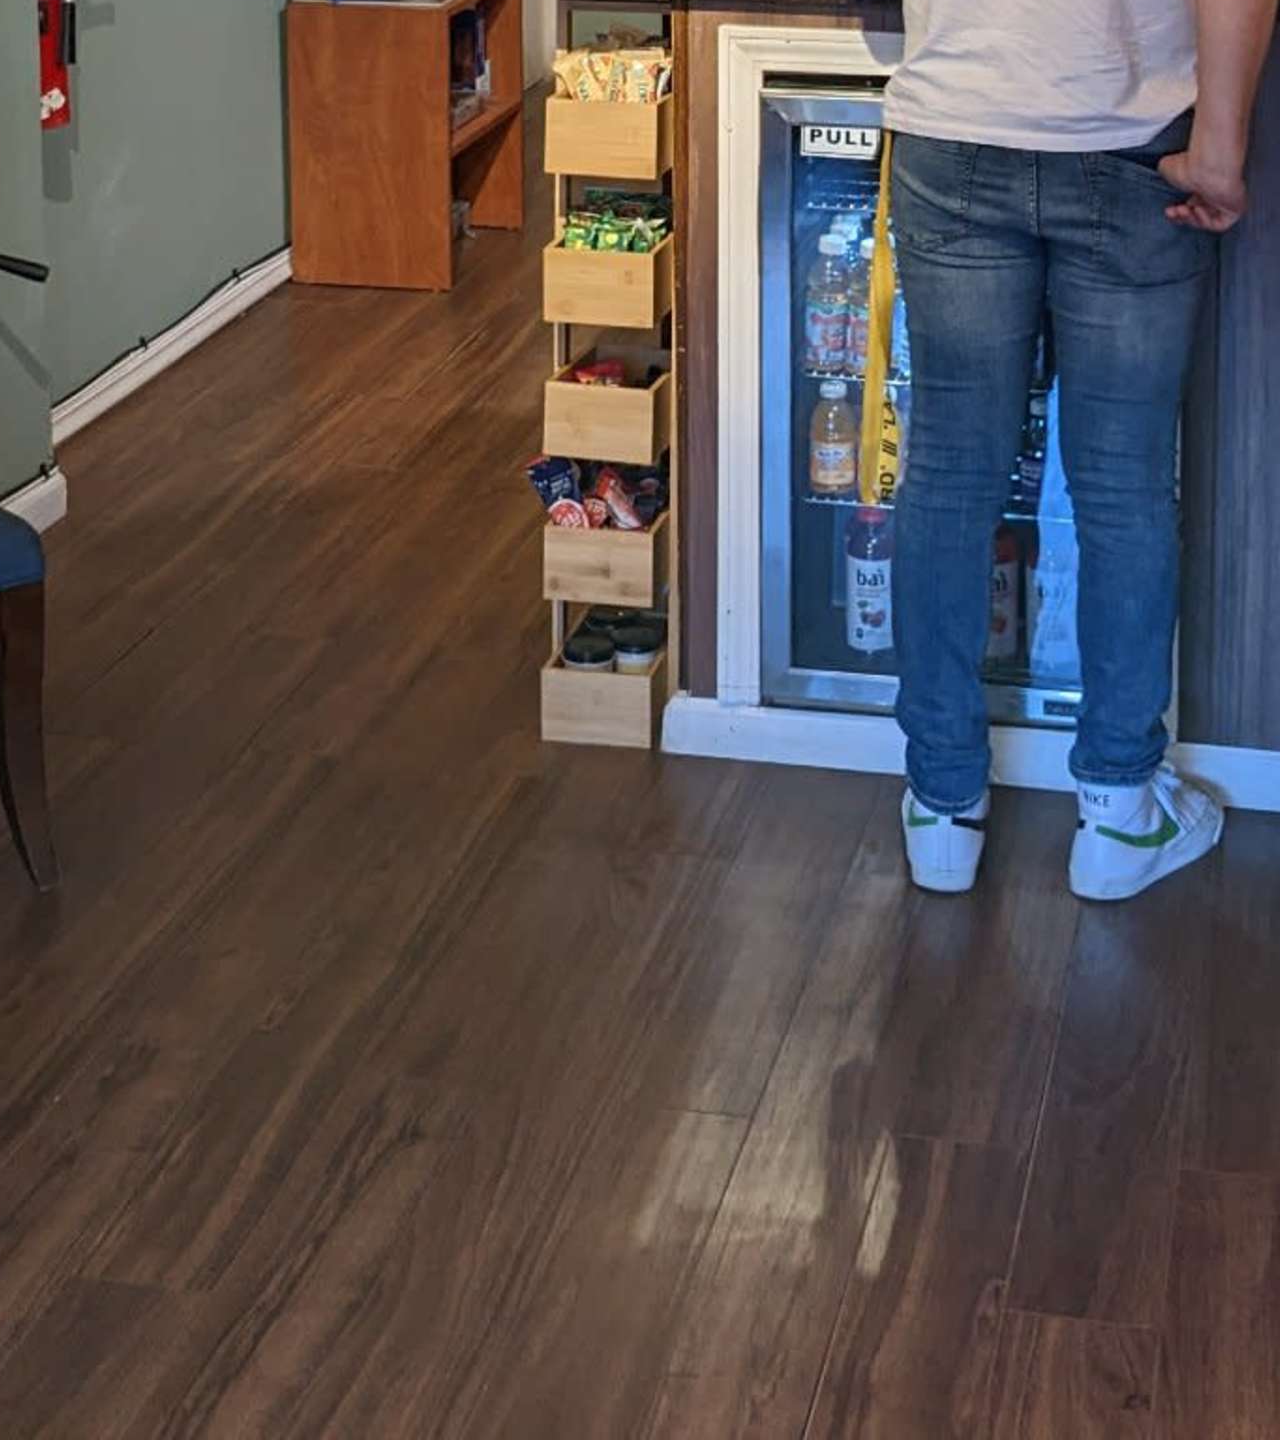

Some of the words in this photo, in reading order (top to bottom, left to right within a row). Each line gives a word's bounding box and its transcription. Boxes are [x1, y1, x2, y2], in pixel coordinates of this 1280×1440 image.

[809, 128, 873, 147] PULL
[855, 569, 886, 587] bai
[1083, 791, 1110, 809] NIKE
